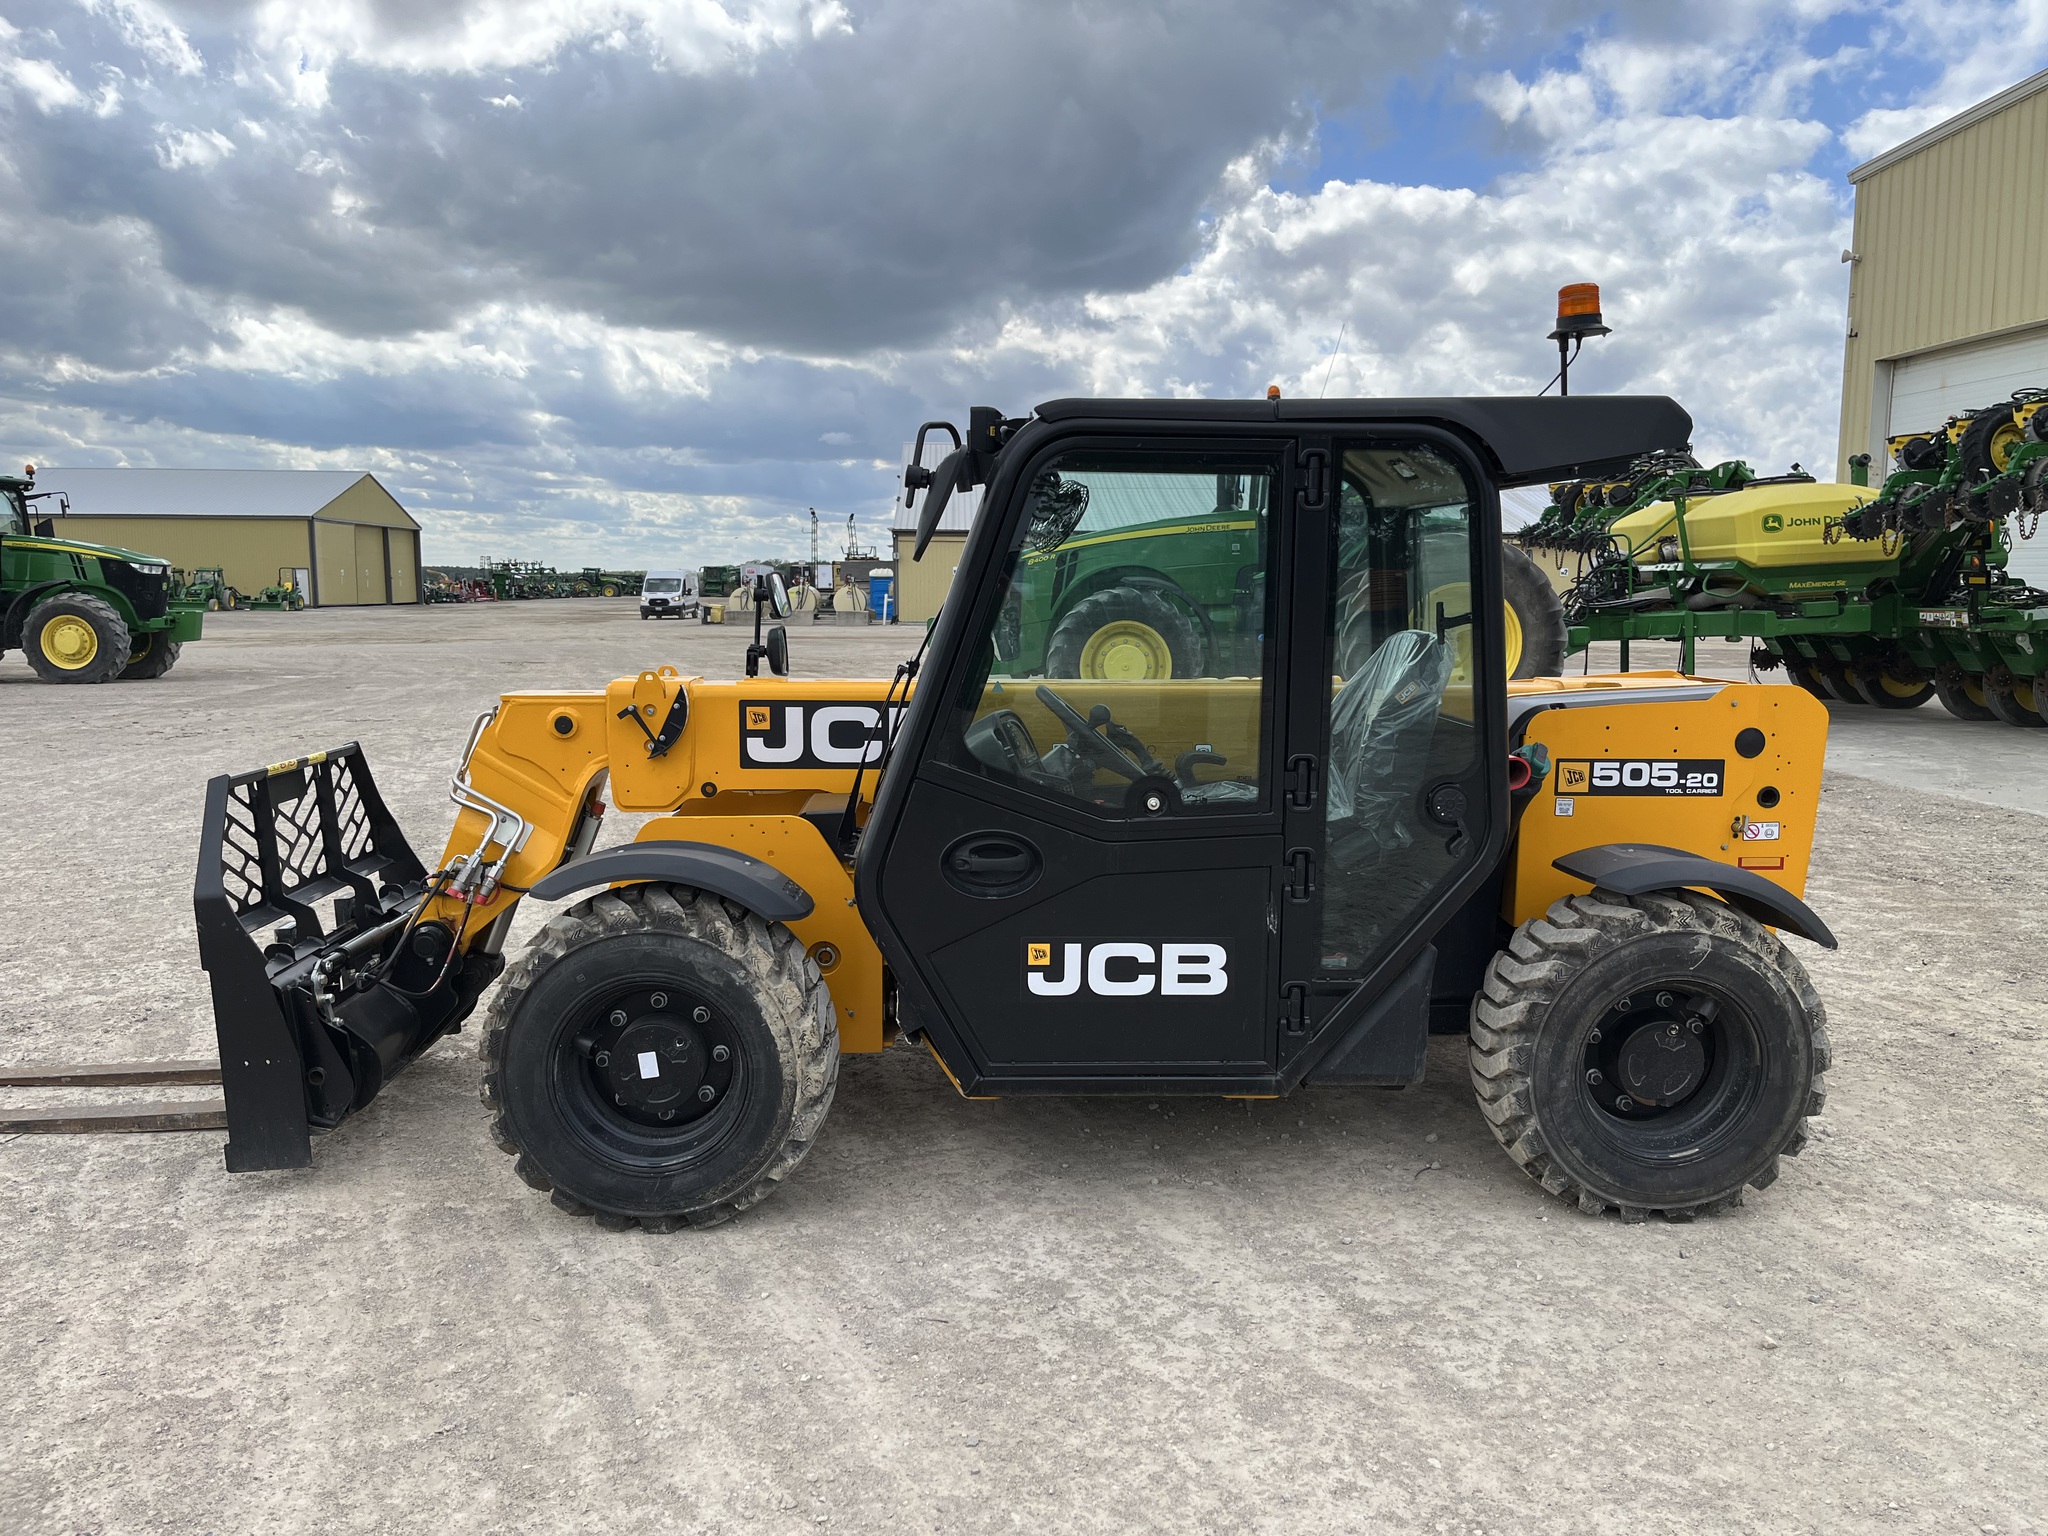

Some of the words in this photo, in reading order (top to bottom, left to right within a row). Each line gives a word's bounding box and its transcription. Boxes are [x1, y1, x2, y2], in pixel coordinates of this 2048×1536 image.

[1206, 524, 1231, 532] DEERE
[1787, 517, 1821, 527] JOHN
[1028, 555, 1049, 566] 8400
[1400, 684, 1416, 701] JCB
[746, 706, 910, 763] JC
[1566, 769, 1585, 785] JCB
[1592, 762, 1718, 787] 505-20
[1027, 942, 1228, 996] JCB
